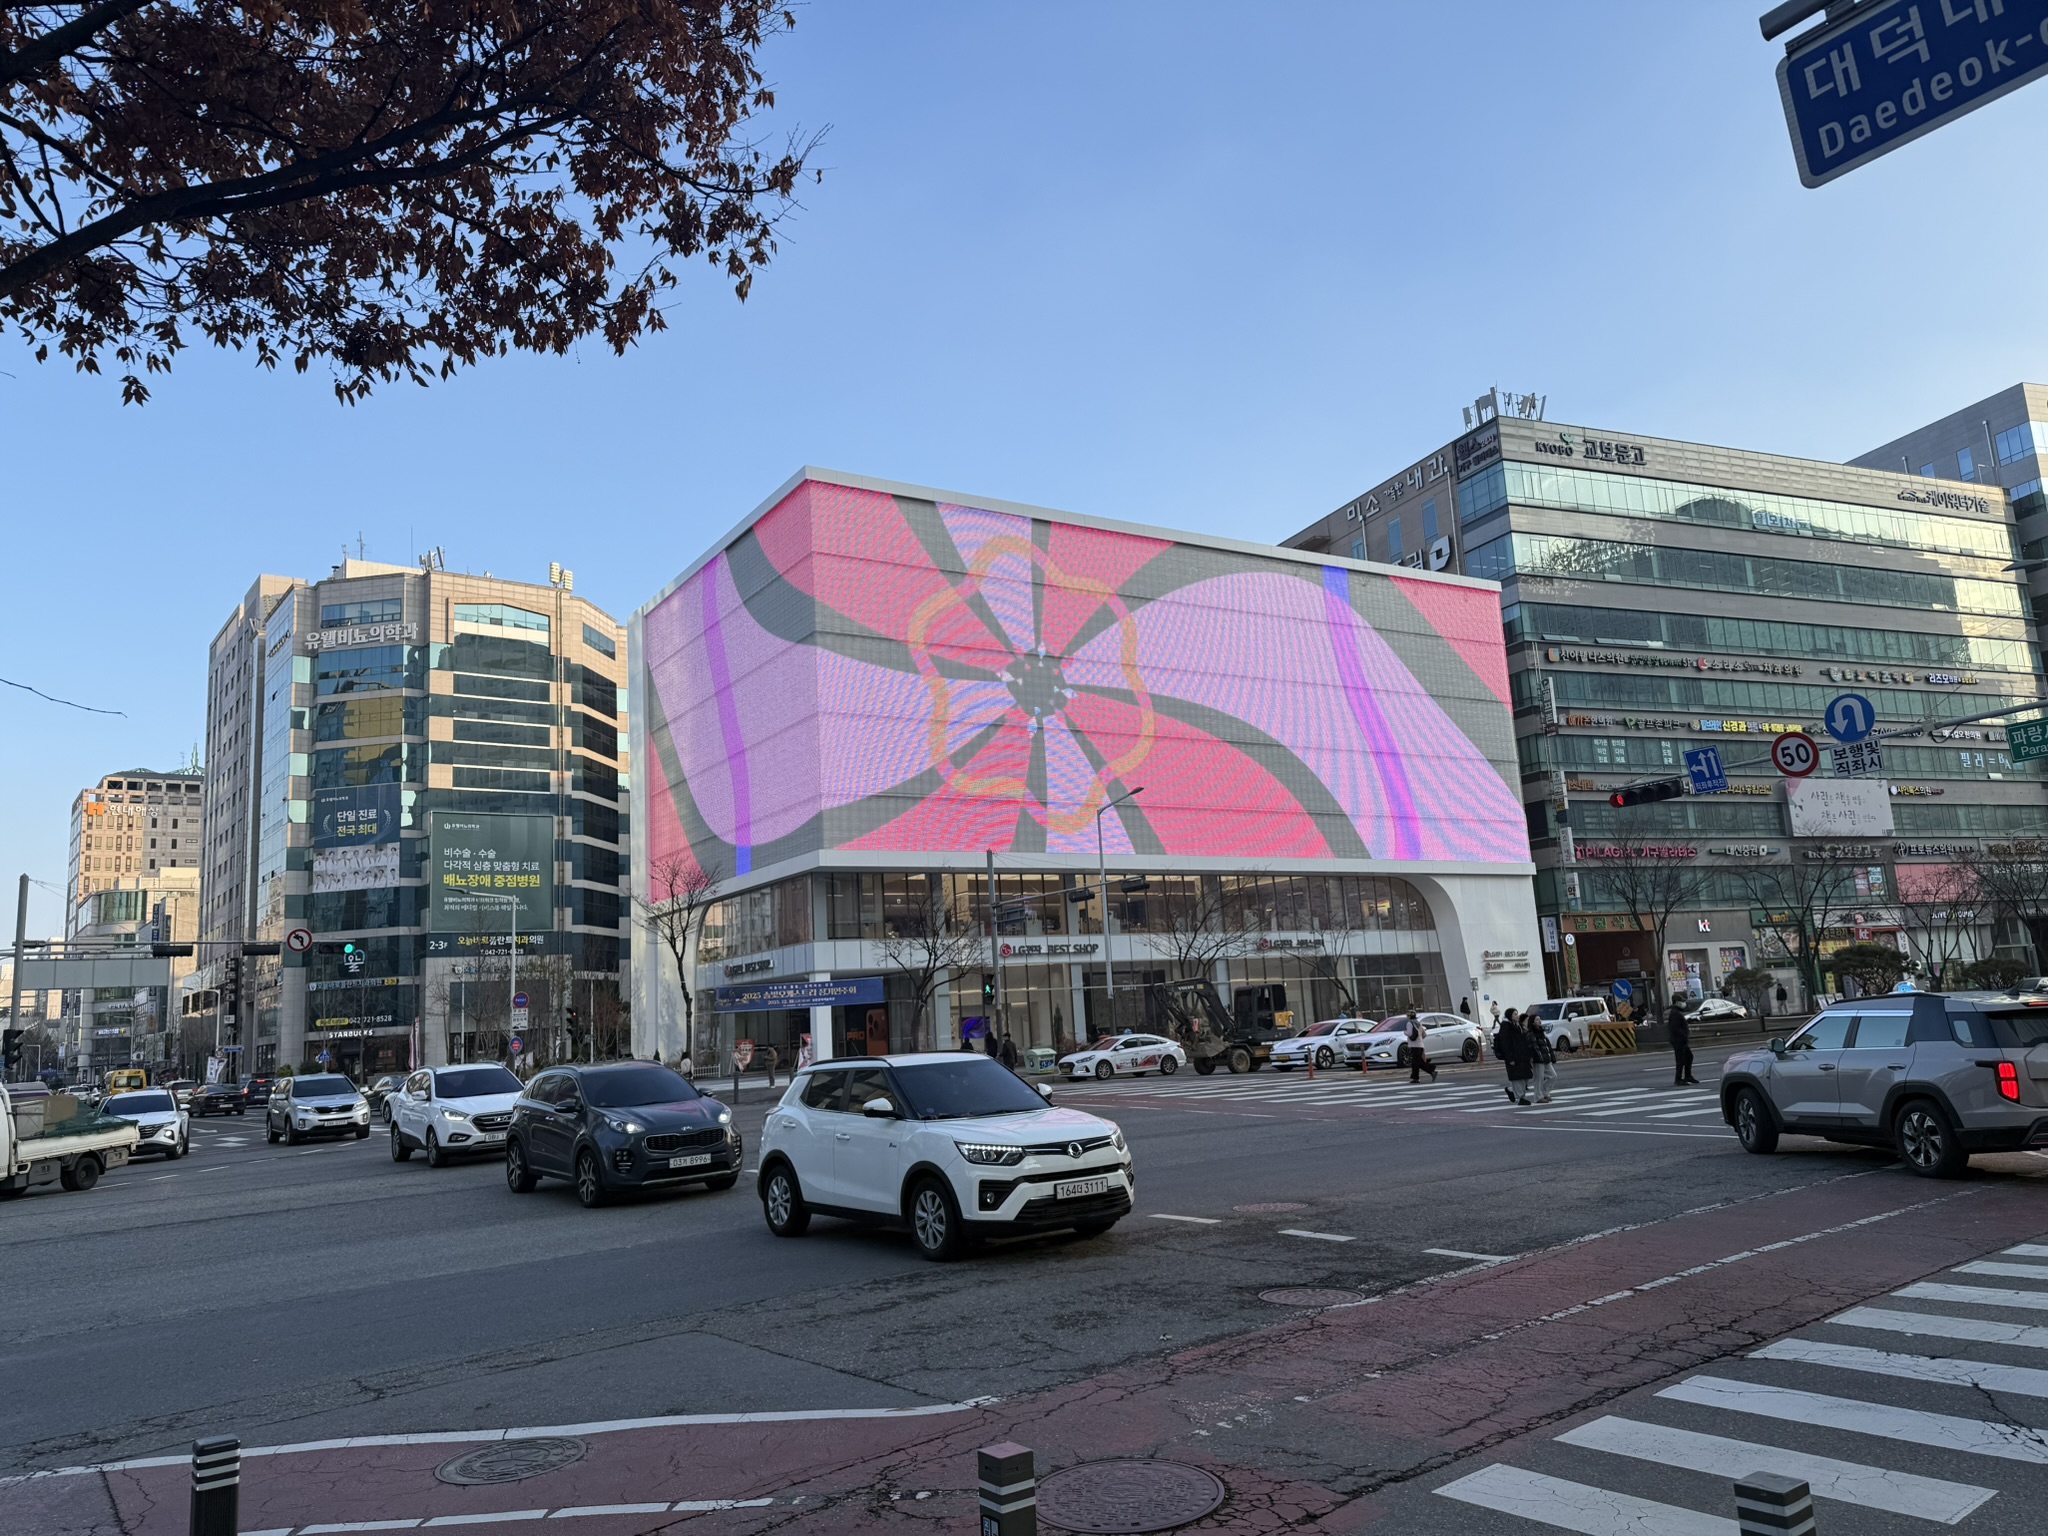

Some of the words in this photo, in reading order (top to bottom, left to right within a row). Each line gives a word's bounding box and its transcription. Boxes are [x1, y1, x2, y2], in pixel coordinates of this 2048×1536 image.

[1535, 441, 1574, 456] KYOBO
[1583, 439, 1647, 466] 교보문고
[1346, 494, 1380, 522] 미소
[1406, 454, 1445, 490] 내과
[304, 622, 419, 650] 유웰비뇨의학과
[1637, 717, 1681, 730] 골프존파크
[1780, 743, 1810, 767] 50
[2021, 744, 2048, 757] Para
[1836, 754, 1883, 775] 직좌시
[110, 804, 160, 817] 현대해상
[337, 809, 356, 823] 단일
[358, 808, 378, 821] 진료
[337, 824, 356, 837] 전국
[358, 822, 377, 835] 최대
[443, 847, 471, 858] 비수술
[478, 848, 497, 859] 수술
[1726, 844, 1758, 856] 대신증권
[1910, 843, 1954, 855] 프로듀스의원
[443, 860, 471, 871] 다각적
[473, 861, 491, 871] 심층
[493, 861, 520, 872] 맞춤형
[522, 862, 540, 872] 치료
[443, 873, 491, 888] 배뇨장애
[494, 874, 541, 888] 중점병원
[1698, 919, 1711, 932] kt
[1859, 929, 1869, 940] kt
[1047, 944, 1071, 954] BEST
[1073, 943, 1099, 954] SHOP
[1504, 950, 1516, 958] BEST
[742, 992, 761, 1000] 2025
[328, 1029, 374, 1039] STARBUCKS
[846, 1031, 865, 1041] PRO
